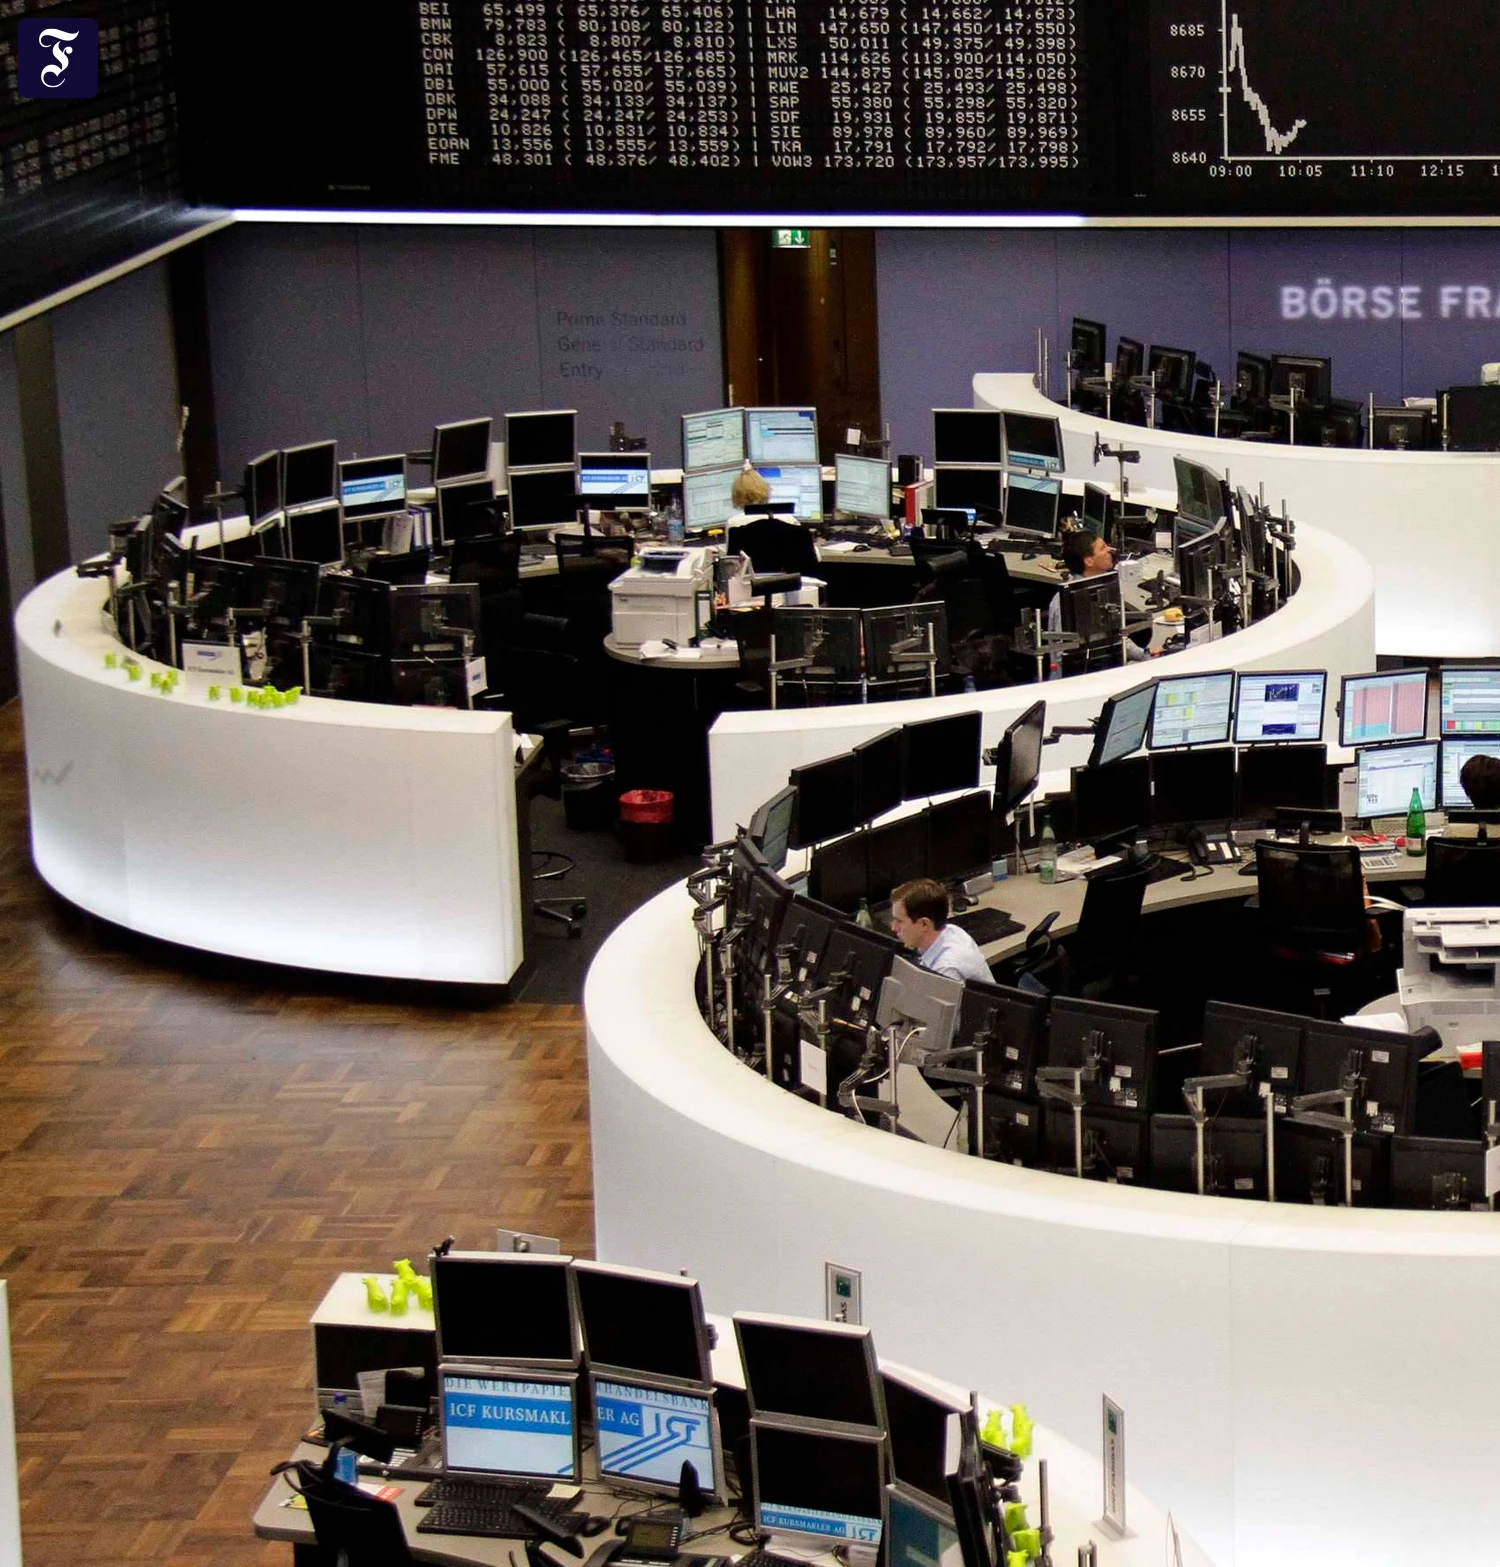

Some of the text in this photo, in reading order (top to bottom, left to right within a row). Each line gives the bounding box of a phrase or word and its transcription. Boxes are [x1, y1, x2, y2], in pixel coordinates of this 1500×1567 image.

[420, 3, 448, 15] BEI
[484, 4, 545, 16] 65,499
[766, 7, 889, 19] LHA 14,679
[421, 18, 451, 29] BMW
[485, 19, 546, 31] 79,783
[767, 22, 889, 34] LIN 147,650
[1170, 24, 1204, 36] 8685
[422, 33, 452, 44] CBK
[496, 34, 547, 46] 8,823
[767, 37, 888, 49] LXS 50,011
[423, 48, 453, 60] CON
[477, 49, 547, 61] 126,900
[768, 51, 890, 64] MRK 114,626
[424, 63, 452, 75] DAI
[487, 64, 548, 76] 57,615
[768, 67, 891, 79] MUV2 144,875
[1171, 66, 1205, 78] 8670
[488, 79, 549, 91] 55,000
[769, 81, 891, 94] RWE 25,427
[426, 93, 455, 104] DBK
[489, 94, 550, 106] 34,088
[770, 96, 892, 108] SAP 55,380
[427, 108, 457, 120] DPW
[490, 109, 551, 120] 24,247
[771, 111, 891, 123] SDF 19,931
[1172, 109, 1206, 121] 8655
[428, 123, 457, 134] DTE
[493, 124, 552, 135] 10,826
[771, 126, 893, 138] SIE 89,978
[493, 139, 552, 150] 13,556
[772, 141, 892, 153] TKA 17,791
[430, 153, 459, 164] FME
[493, 154, 551, 165] 48,301
[772, 156, 894, 167] VOW3 173,720
[1173, 152, 1206, 163] 8640
[1210, 165, 1251, 177] 09:00
[1280, 165, 1322, 176] 10:05
[1352, 165, 1393, 176] 11:10
[1422, 165, 1463, 176] 12:15
[1280, 277, 1421, 319] BÖRSE
[611, 311, 687, 327] Standard
[560, 362, 603, 379] Entry
[450, 1403, 571, 1425] ICF KURSMAKL
[620, 1412, 640, 1426] AG
